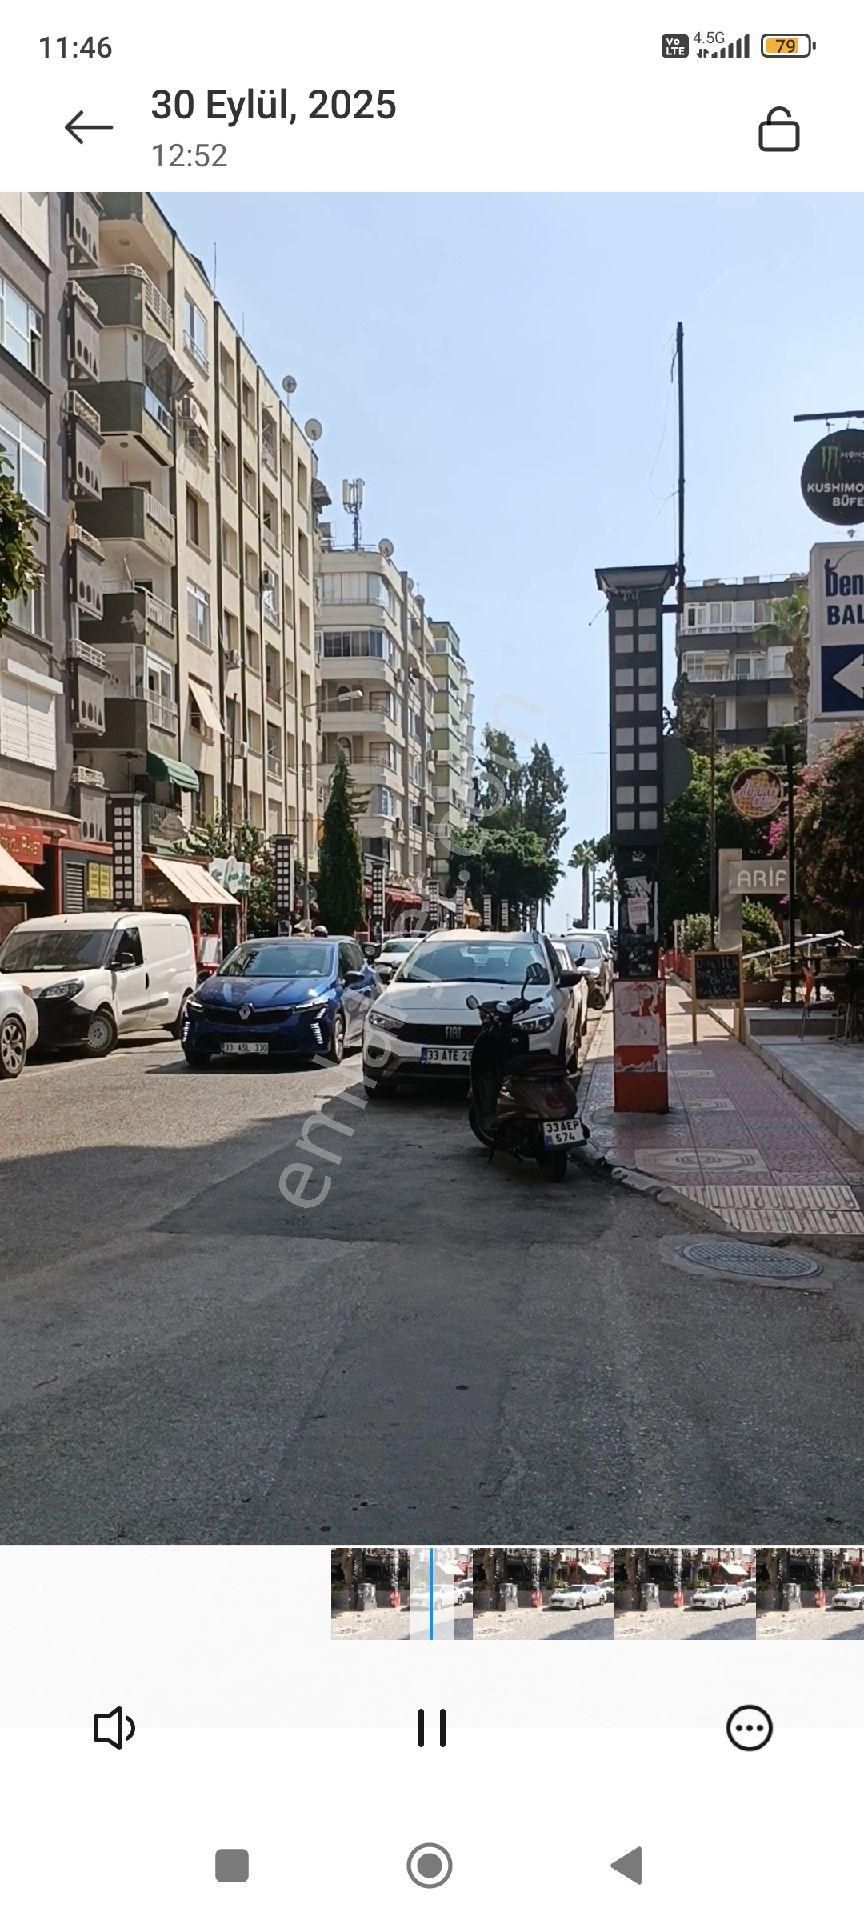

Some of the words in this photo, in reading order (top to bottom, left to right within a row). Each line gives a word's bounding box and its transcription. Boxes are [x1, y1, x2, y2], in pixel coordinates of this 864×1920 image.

[693, 31, 725, 44] 4.5G
[39, 36, 112, 60] 11:46
[665, 46, 686, 56] LTE
[775, 39, 796, 53] 79
[151, 89, 195, 120] 30
[206, 88, 297, 127] Eylül,
[308, 89, 397, 120] 2025
[152, 144, 228, 168] 12:52
[832, 494, 864, 507] BÜFE
[445, 1026, 462, 1040] FIAT
[428, 1050, 439, 1061] 33
[441, 1050, 459, 1061] ATE
[545, 1122, 559, 1133] 33
[560, 1120, 579, 1131] AEP
